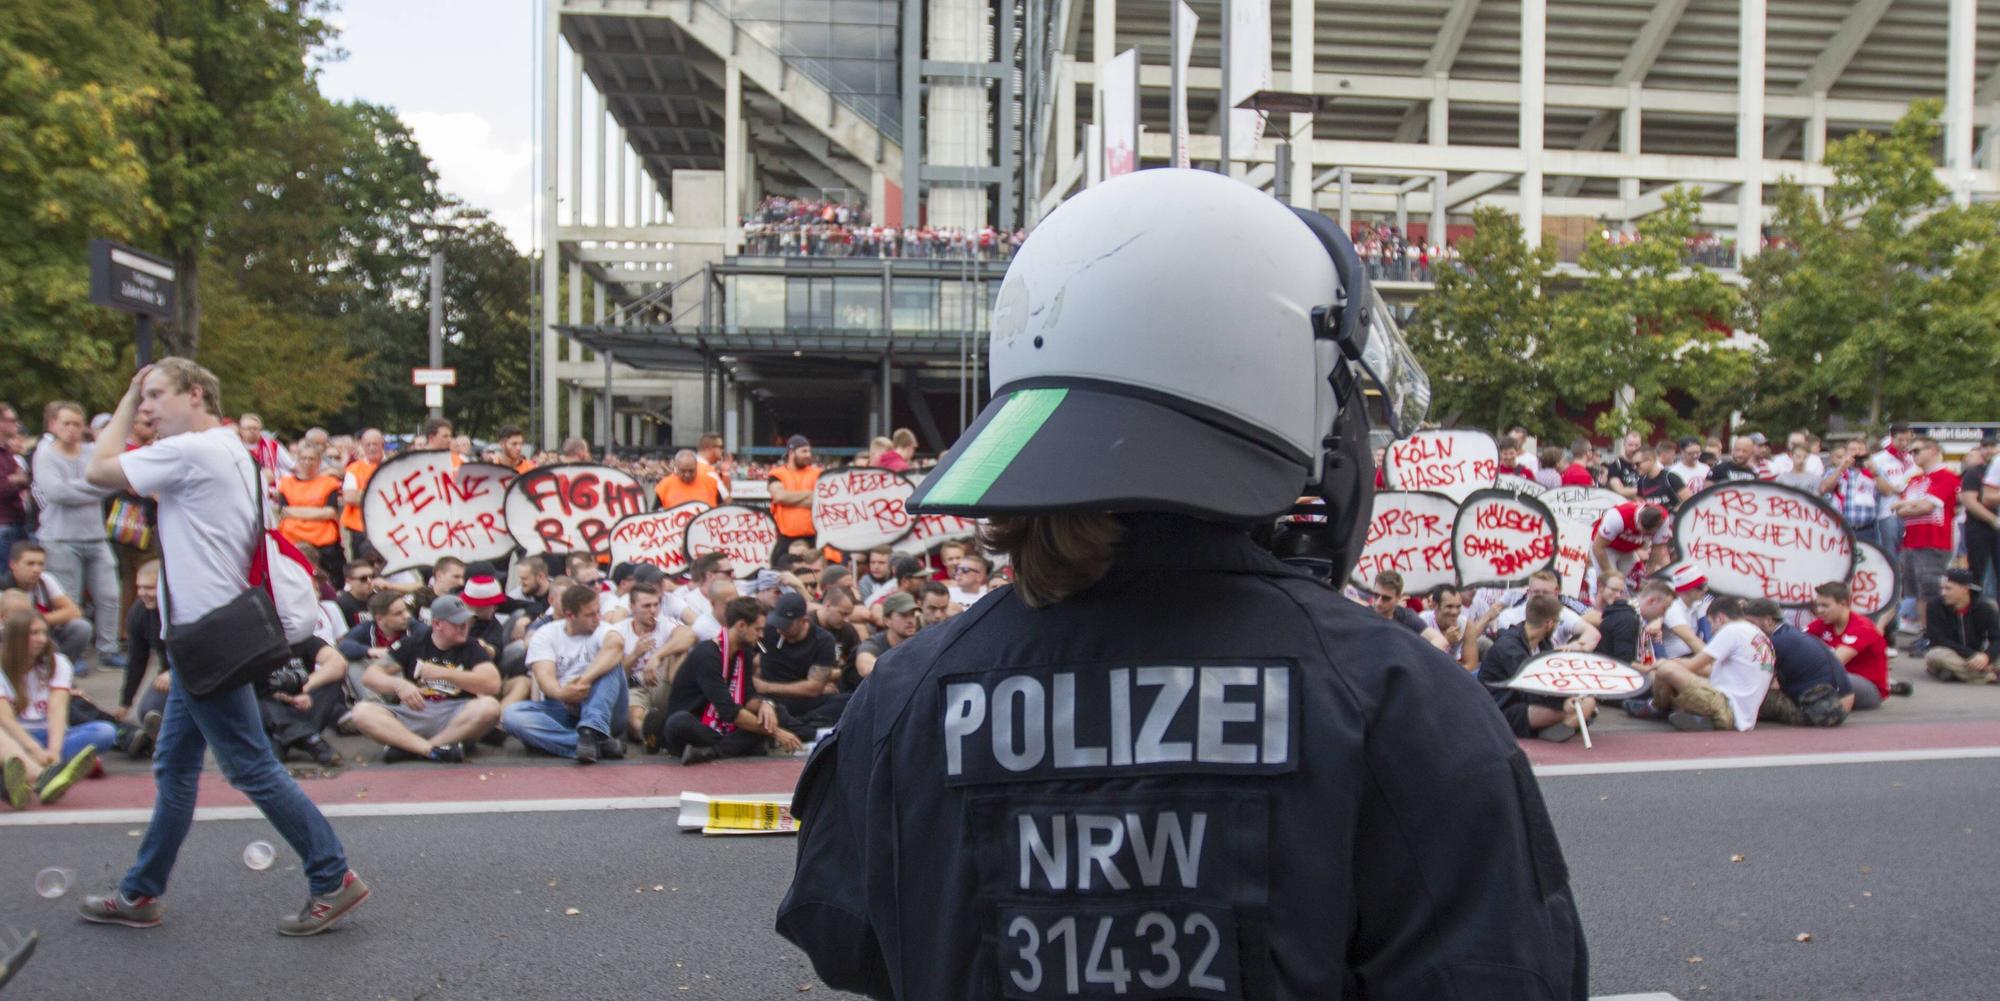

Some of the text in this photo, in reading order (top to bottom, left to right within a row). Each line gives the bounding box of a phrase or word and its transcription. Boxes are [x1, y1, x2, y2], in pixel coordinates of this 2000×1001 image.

[1394, 436, 1453, 467] KÖLN
[1400, 459, 1498, 490] HASST RB
[526, 472, 646, 517] FIGHT
[1715, 489, 1758, 516] RB
[387, 507, 508, 557] FICKT R
[868, 498, 907, 531] RB
[1476, 503, 1544, 535] KÖLSCH
[1691, 508, 1813, 550] MENSCHEN
[1687, 536, 1787, 579] VERPISST
[1523, 671, 1641, 690] TÖTET
[1546, 657, 1617, 672] GELD
[945, 666, 1289, 775] POLIZEI
[1018, 812, 1207, 890] NRW
[1008, 912, 1226, 994] 31432
